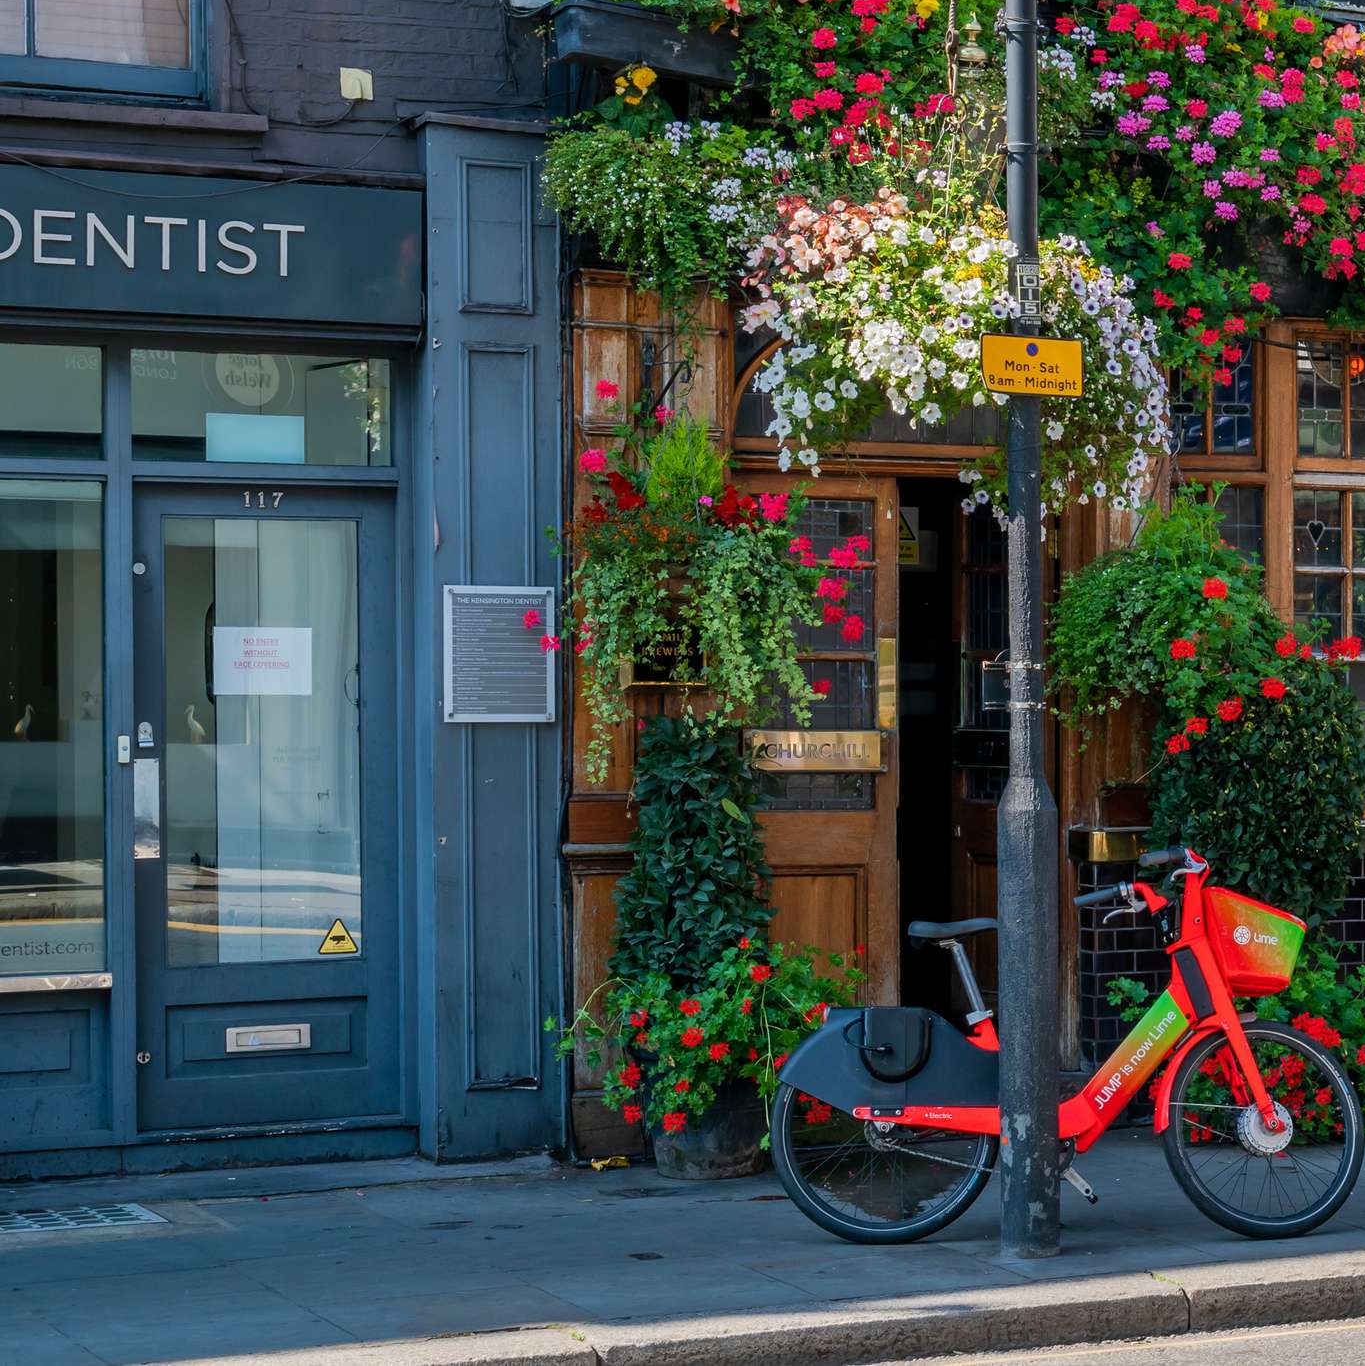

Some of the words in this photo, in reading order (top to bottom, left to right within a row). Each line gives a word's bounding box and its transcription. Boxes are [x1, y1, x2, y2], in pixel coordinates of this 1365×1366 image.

[1005, 360, 1030, 372] Mon
[1039, 362, 1060, 374] Sat
[1025, 378, 1077, 391] Midnight
[243, 491, 284, 508] 117
[471, 597, 514, 605] KENSINGTON
[764, 743, 870, 759] CHURCHILL
[1253, 933, 1279, 945] Lime
[1094, 1072, 1123, 1110] JUMP
[1120, 1063, 1134, 1076] is
[1130, 1037, 1153, 1066] now
[1149, 1010, 1177, 1040] Lime
